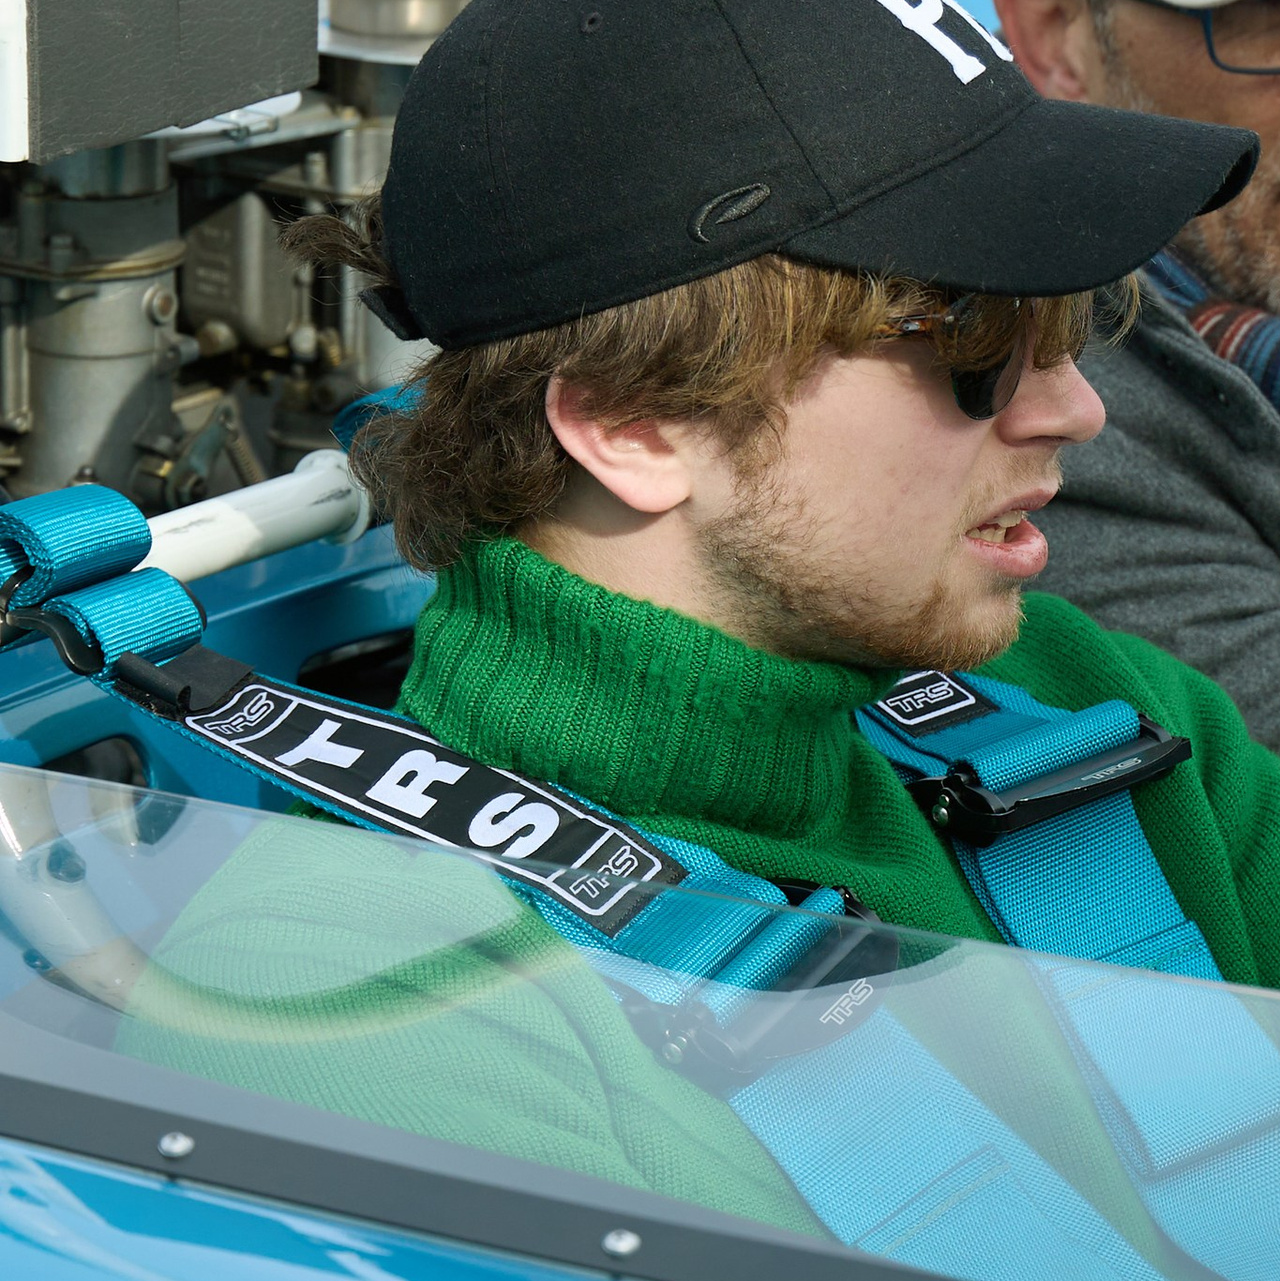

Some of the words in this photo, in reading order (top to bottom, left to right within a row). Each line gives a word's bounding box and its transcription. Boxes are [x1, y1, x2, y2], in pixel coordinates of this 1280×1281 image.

[204, 690, 275, 737] TRS
[886, 681, 954, 713] TRS
[1081, 756, 1142, 783] TRS
[568, 844, 639, 900] TRS
[819, 977, 874, 1025] TRS
